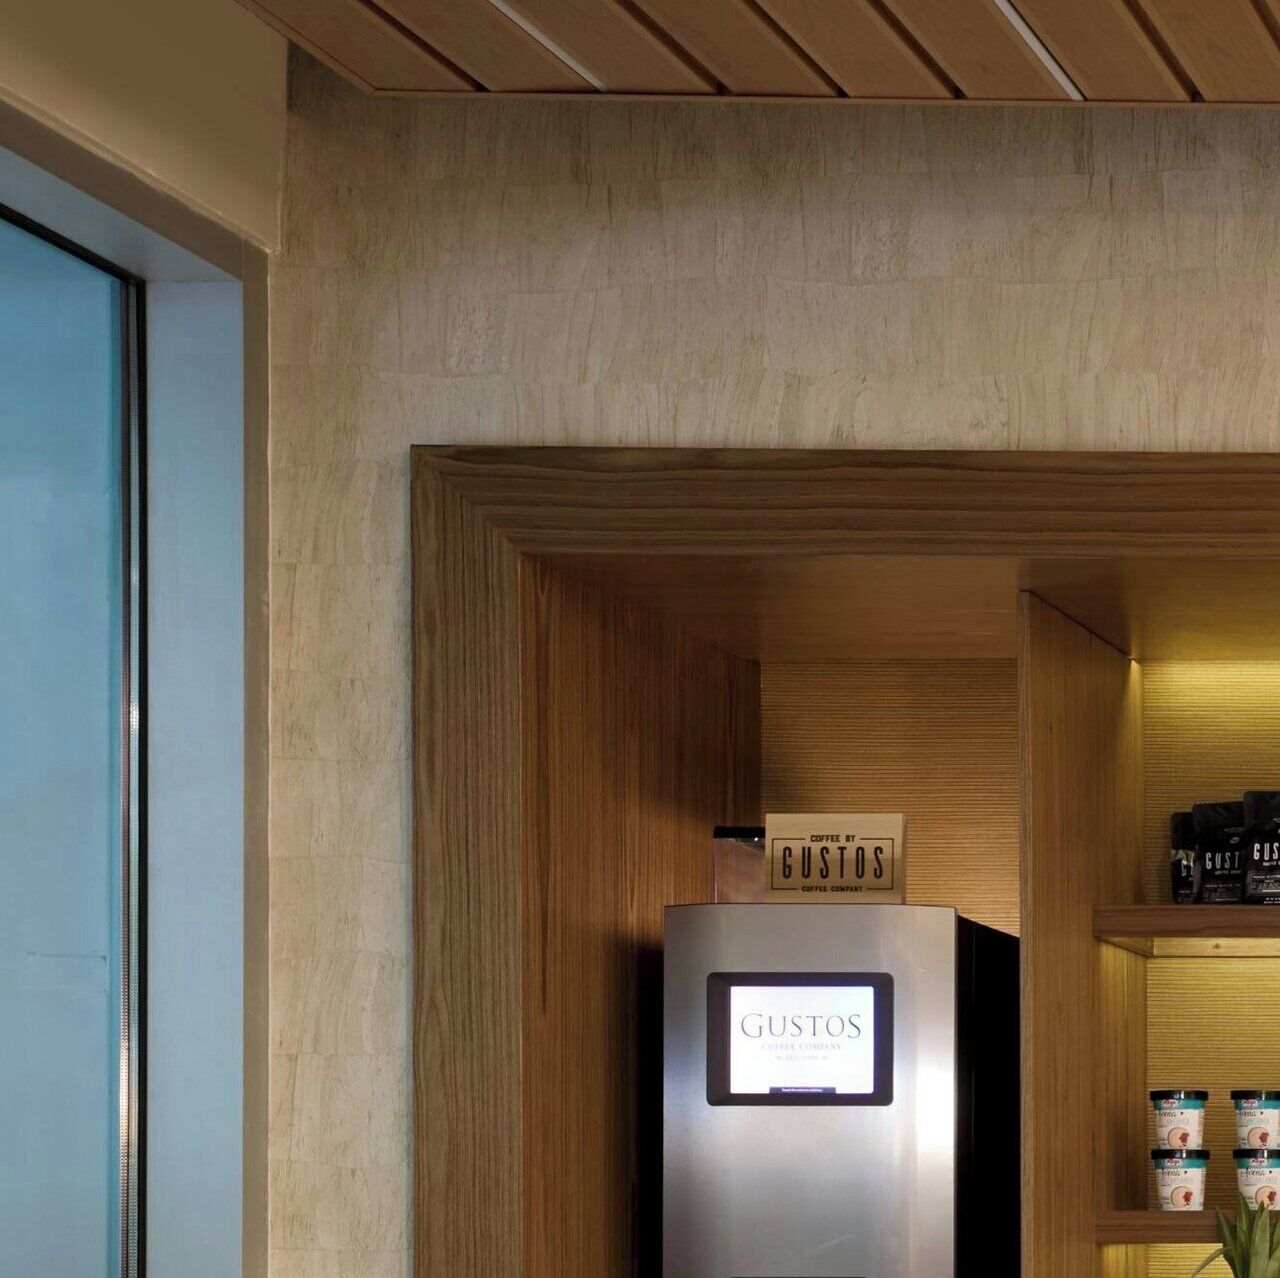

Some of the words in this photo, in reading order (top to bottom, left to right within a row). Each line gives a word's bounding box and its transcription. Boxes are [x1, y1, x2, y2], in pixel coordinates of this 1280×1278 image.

[810, 834, 842, 843] COFFEE
[845, 834, 857, 843] BY
[782, 846, 884, 879] GUSTOS
[1205, 851, 1240, 870] GUST
[801, 885, 828, 893] COFFEE
[830, 885, 863, 893] COMPANY
[741, 1012, 862, 1039] GUSTOS
